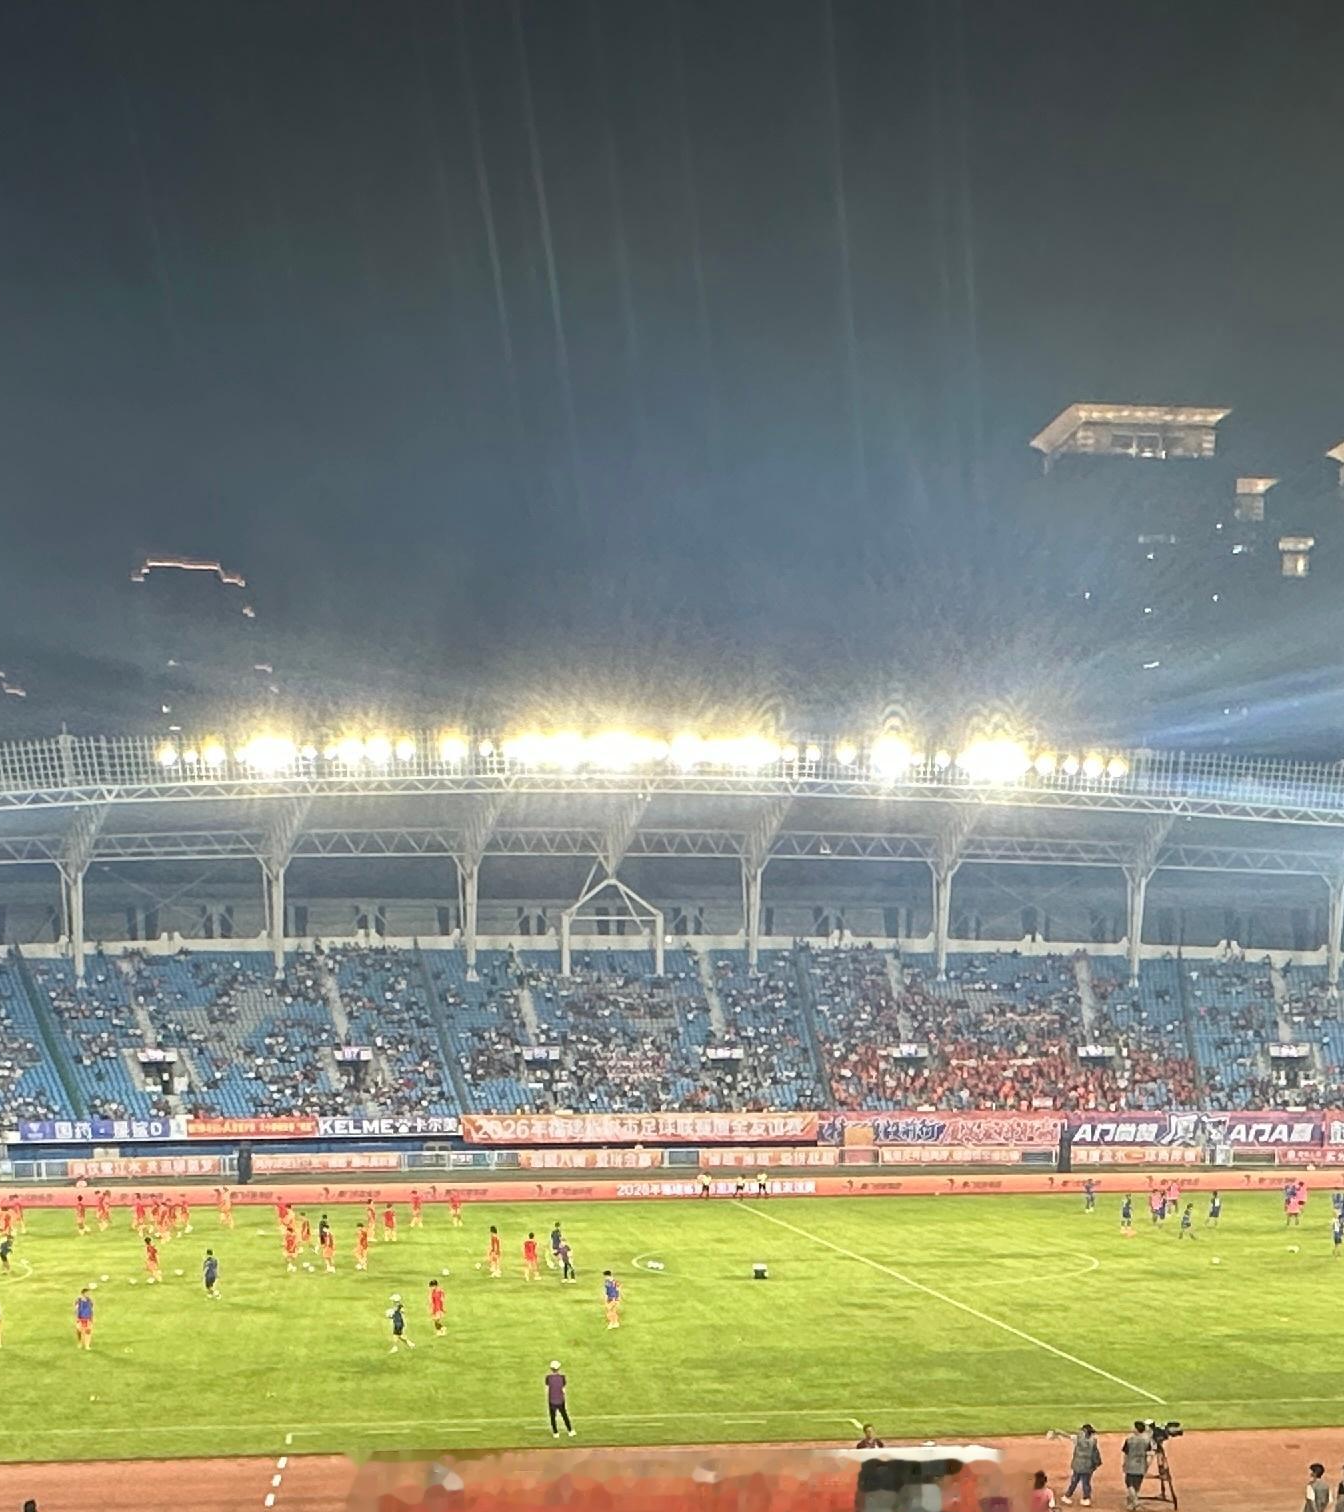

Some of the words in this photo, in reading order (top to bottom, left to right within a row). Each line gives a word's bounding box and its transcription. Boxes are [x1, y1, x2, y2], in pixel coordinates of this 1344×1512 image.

[319, 1118, 394, 1135] KELME
[415, 1116, 458, 1132] 卡尔美
